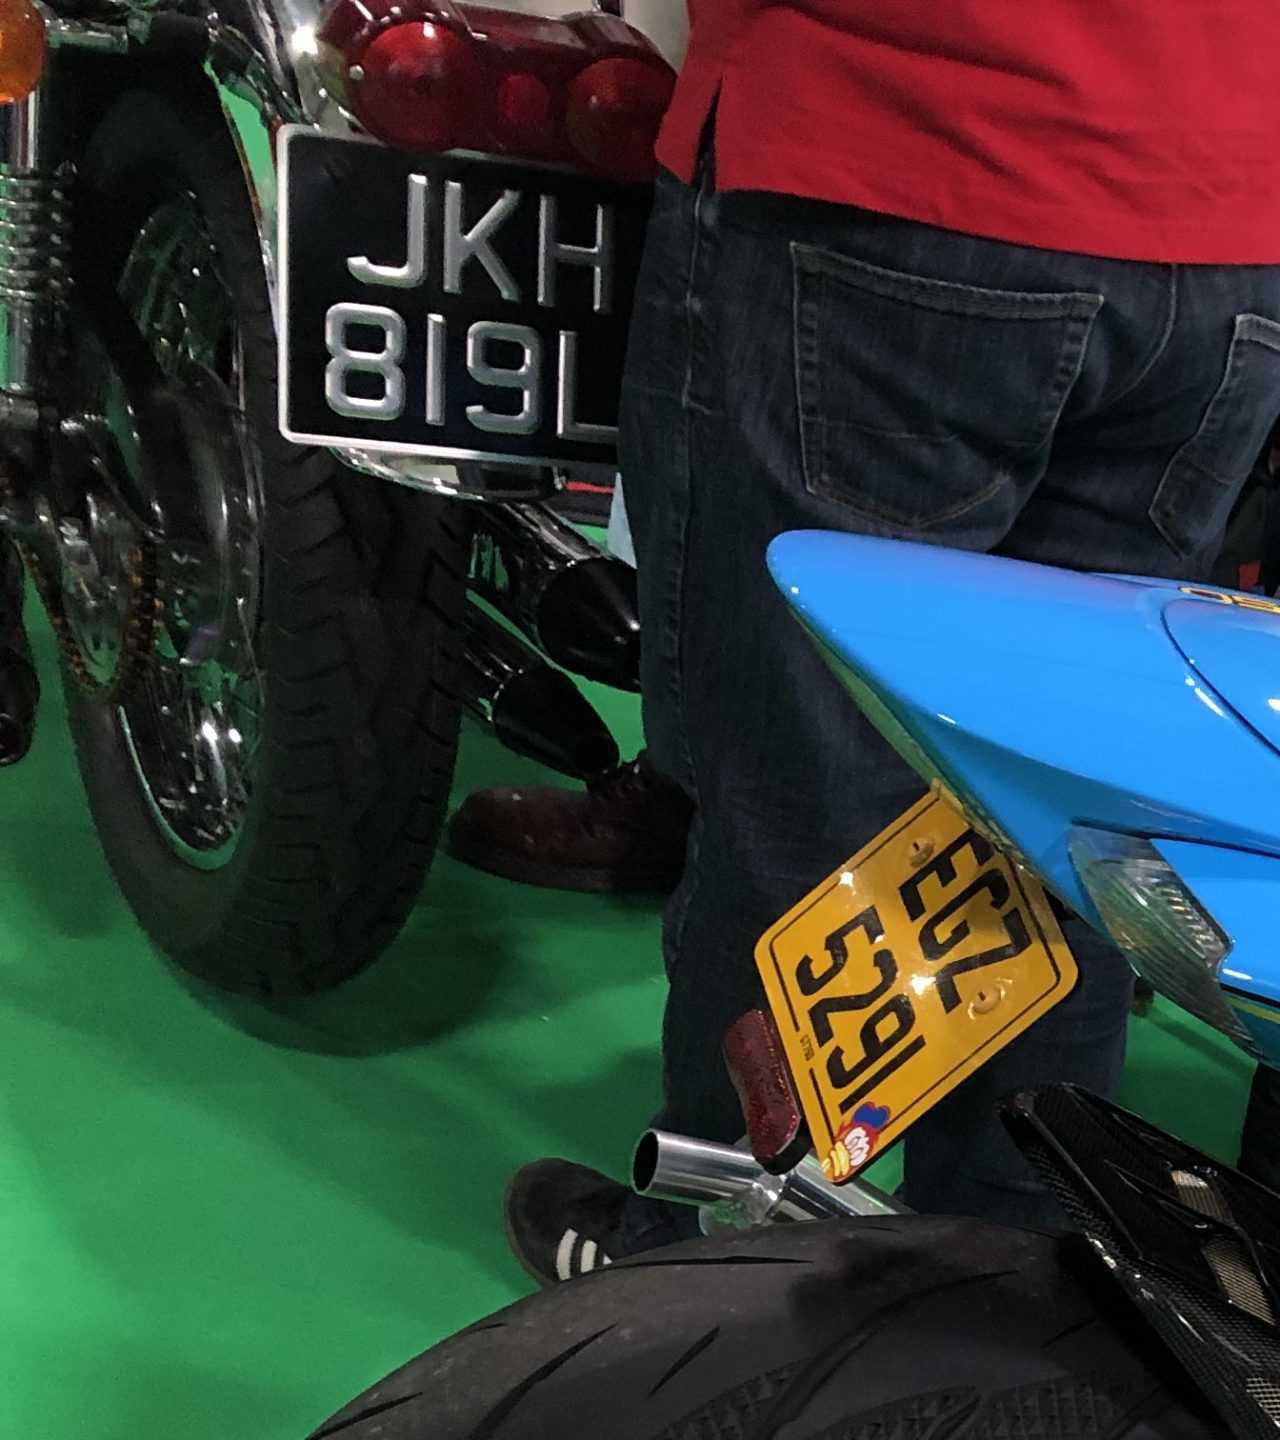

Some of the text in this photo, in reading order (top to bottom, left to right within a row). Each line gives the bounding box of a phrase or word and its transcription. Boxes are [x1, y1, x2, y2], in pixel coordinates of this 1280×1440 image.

[347, 173, 617, 316] JKH
[324, 302, 621, 444] 819L
[898, 828, 1033, 1015] EGZ
[794, 904, 926, 1111] 5291
